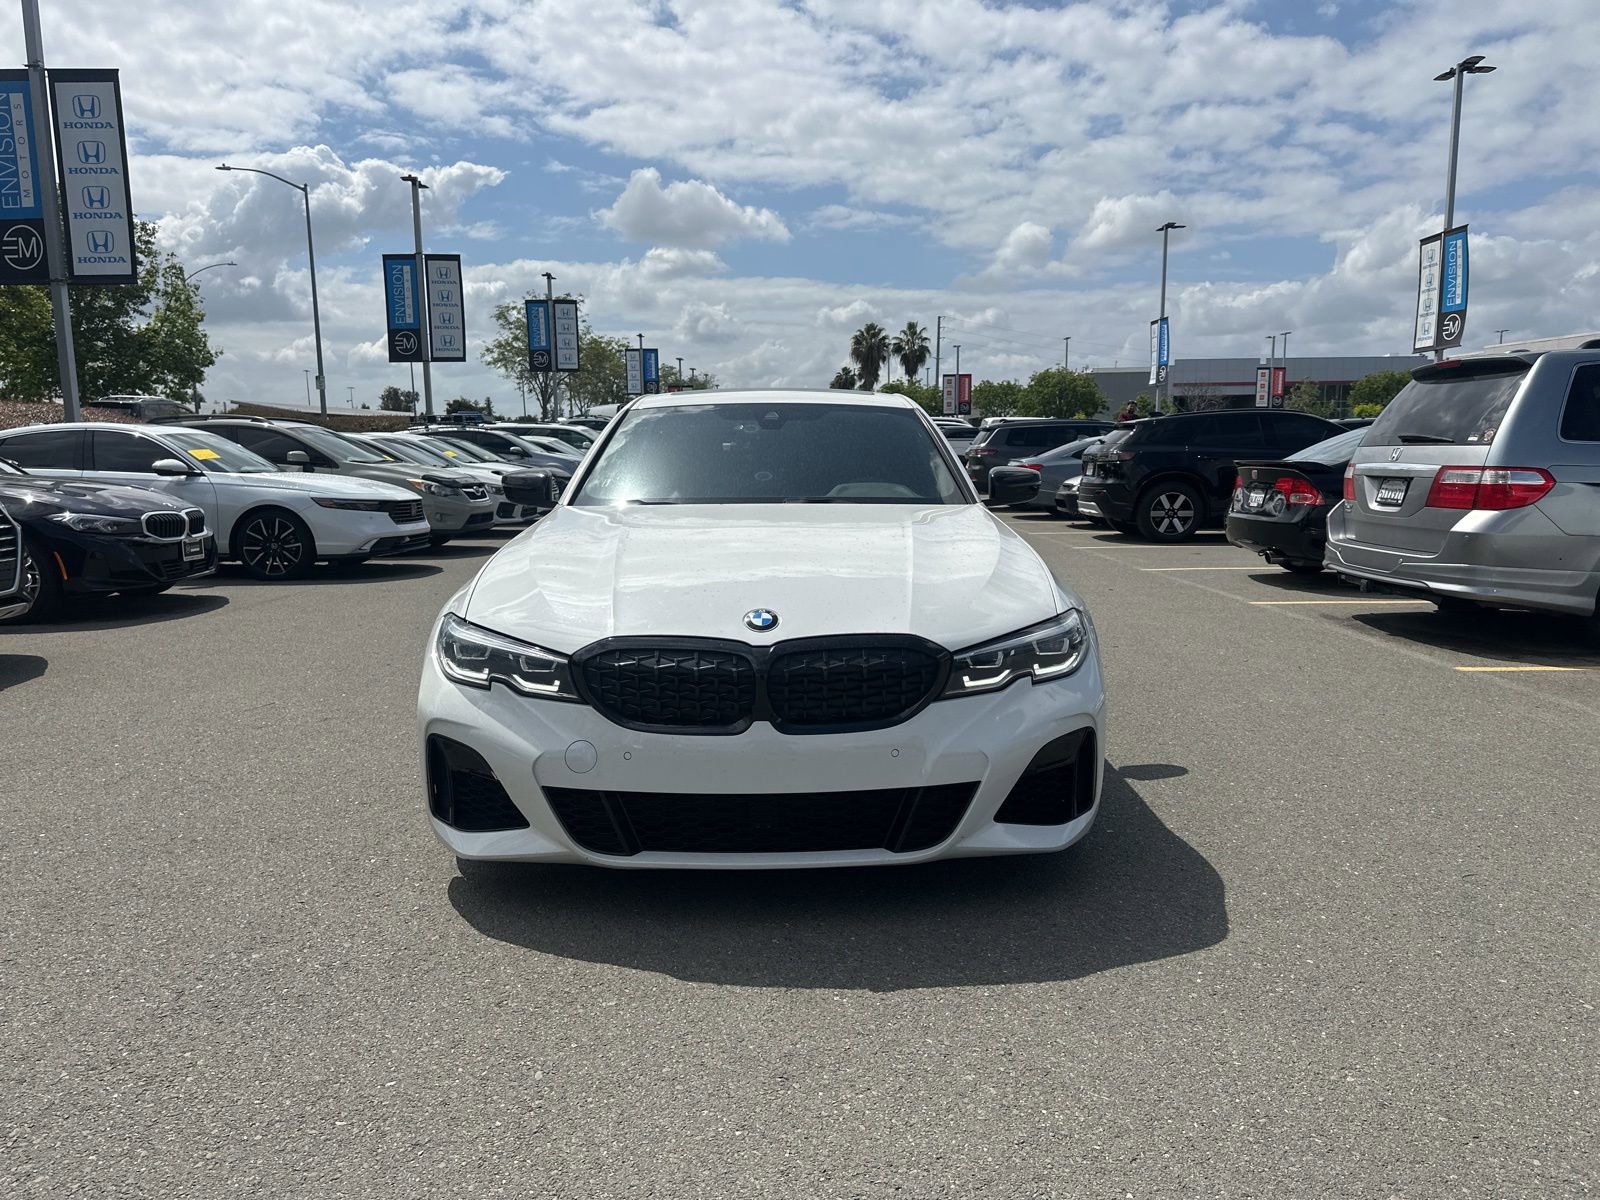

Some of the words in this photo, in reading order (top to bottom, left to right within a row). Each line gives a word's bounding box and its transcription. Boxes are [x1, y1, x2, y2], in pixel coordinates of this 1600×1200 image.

[63, 121, 114, 129] HONDA
[13, 103, 31, 198] MOTORS
[68, 167, 119, 175] HONDA
[73, 212, 123, 220] HONDA
[77, 256, 127, 264] HONDA
[1446, 240, 1457, 306] ENVISION
[392, 264, 406, 324] ENVISION
